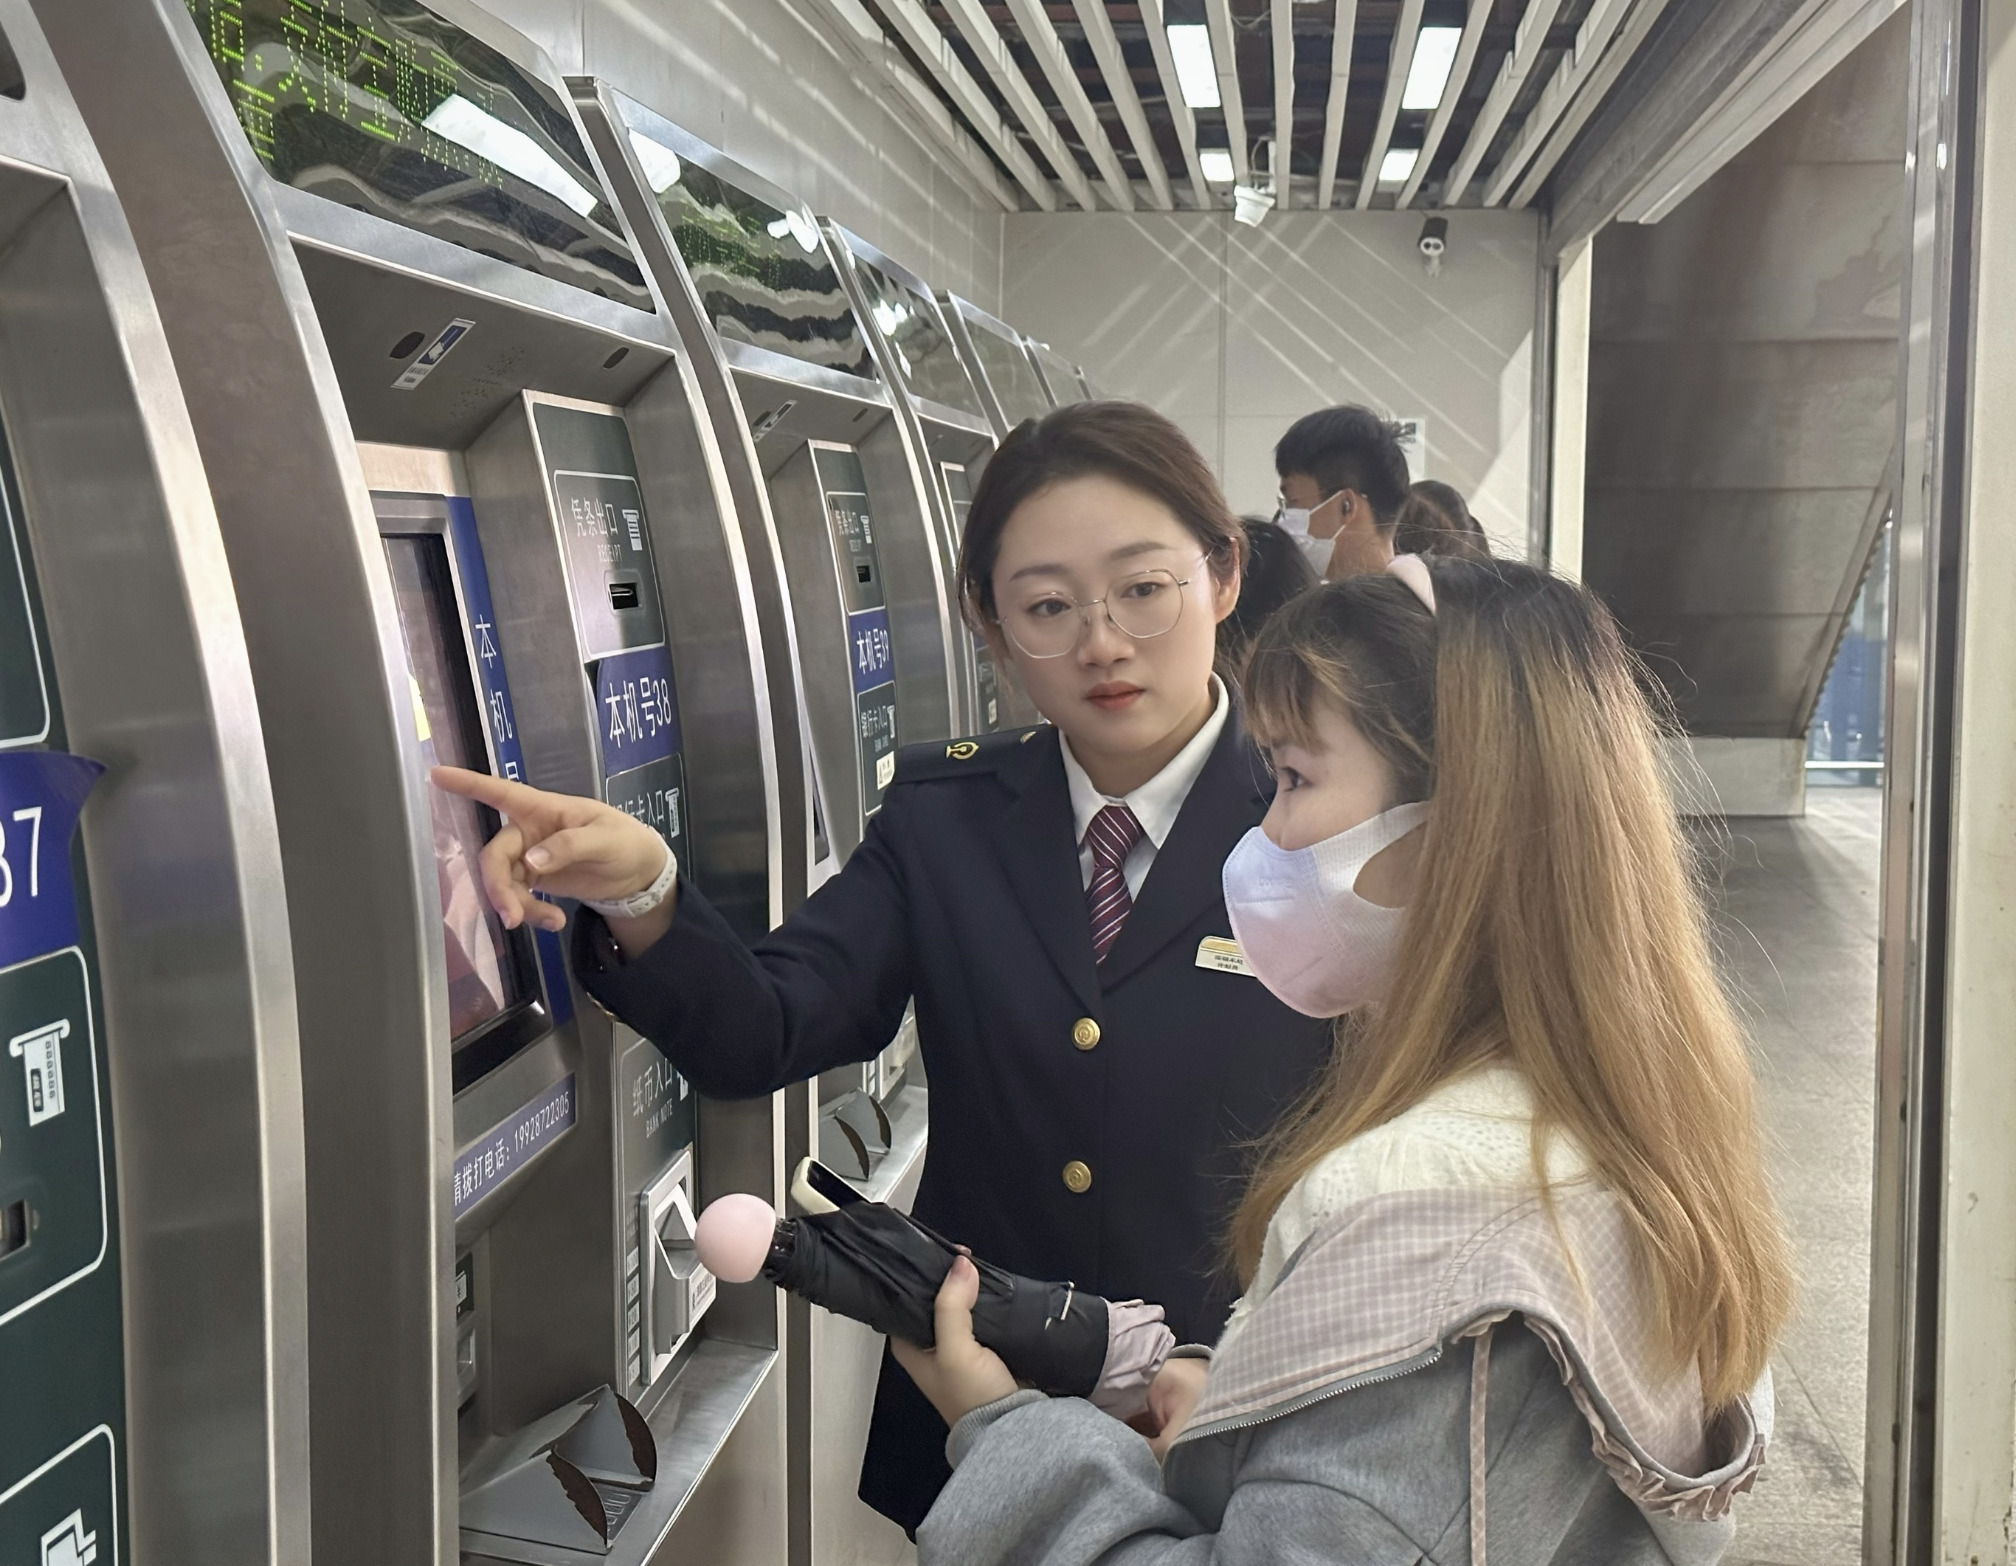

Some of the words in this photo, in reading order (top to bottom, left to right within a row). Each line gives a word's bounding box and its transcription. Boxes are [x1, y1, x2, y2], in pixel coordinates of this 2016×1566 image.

[571, 497, 618, 538] 凭条出口
[856, 628, 890, 675] 本机号39
[605, 676, 672, 748] 本机号38
[612, 790, 665, 828] 卡入口
